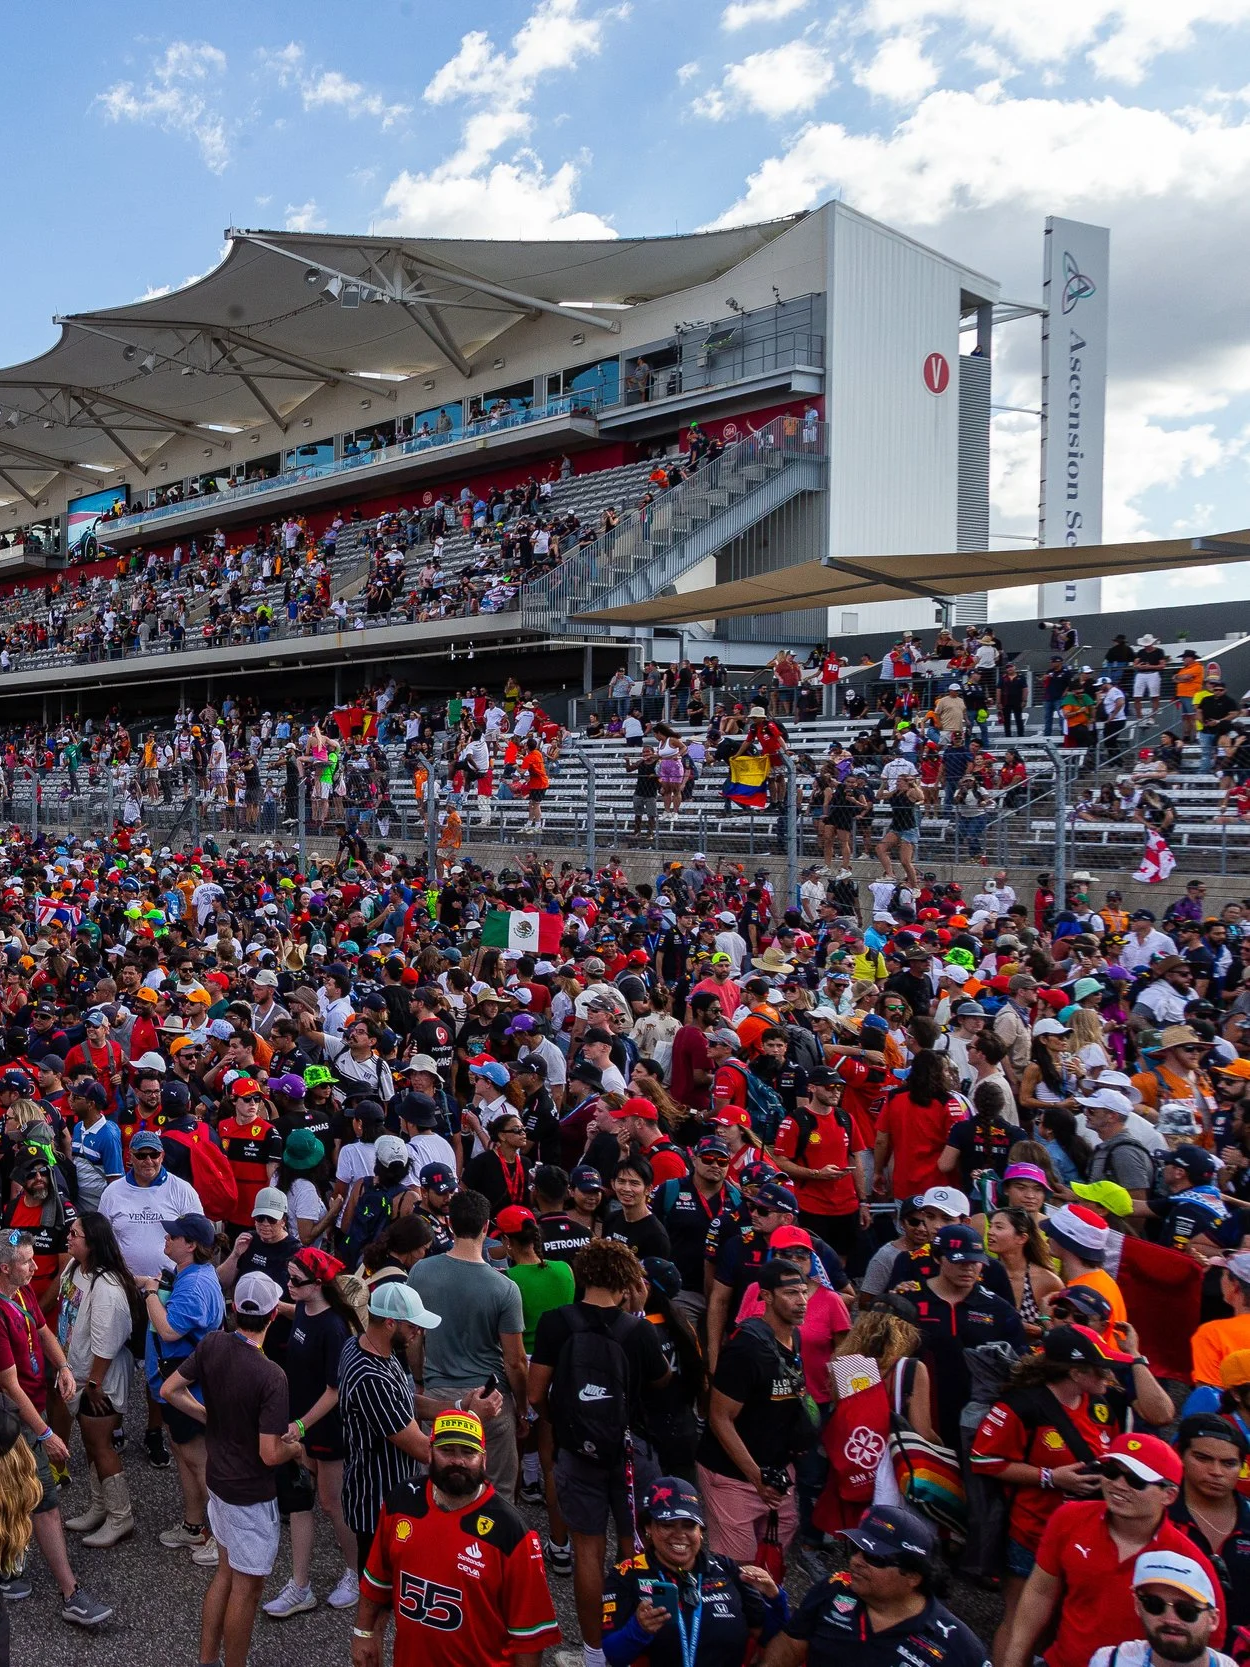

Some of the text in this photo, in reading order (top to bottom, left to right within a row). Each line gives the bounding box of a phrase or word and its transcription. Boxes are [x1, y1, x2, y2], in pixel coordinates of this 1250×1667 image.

[932, 357, 942, 390] V
[1064, 329, 1087, 602] Ascension Sen
[543, 1236, 592, 1252] PETRONAS
[584, 1383, 607, 1396] NIKE
[440, 1418, 479, 1433] Ferrari
[849, 1472, 867, 1484] SAN
[457, 1552, 486, 1569] Santander
[398, 1570, 463, 1631] 55
[701, 1593, 725, 1603] Mobil
